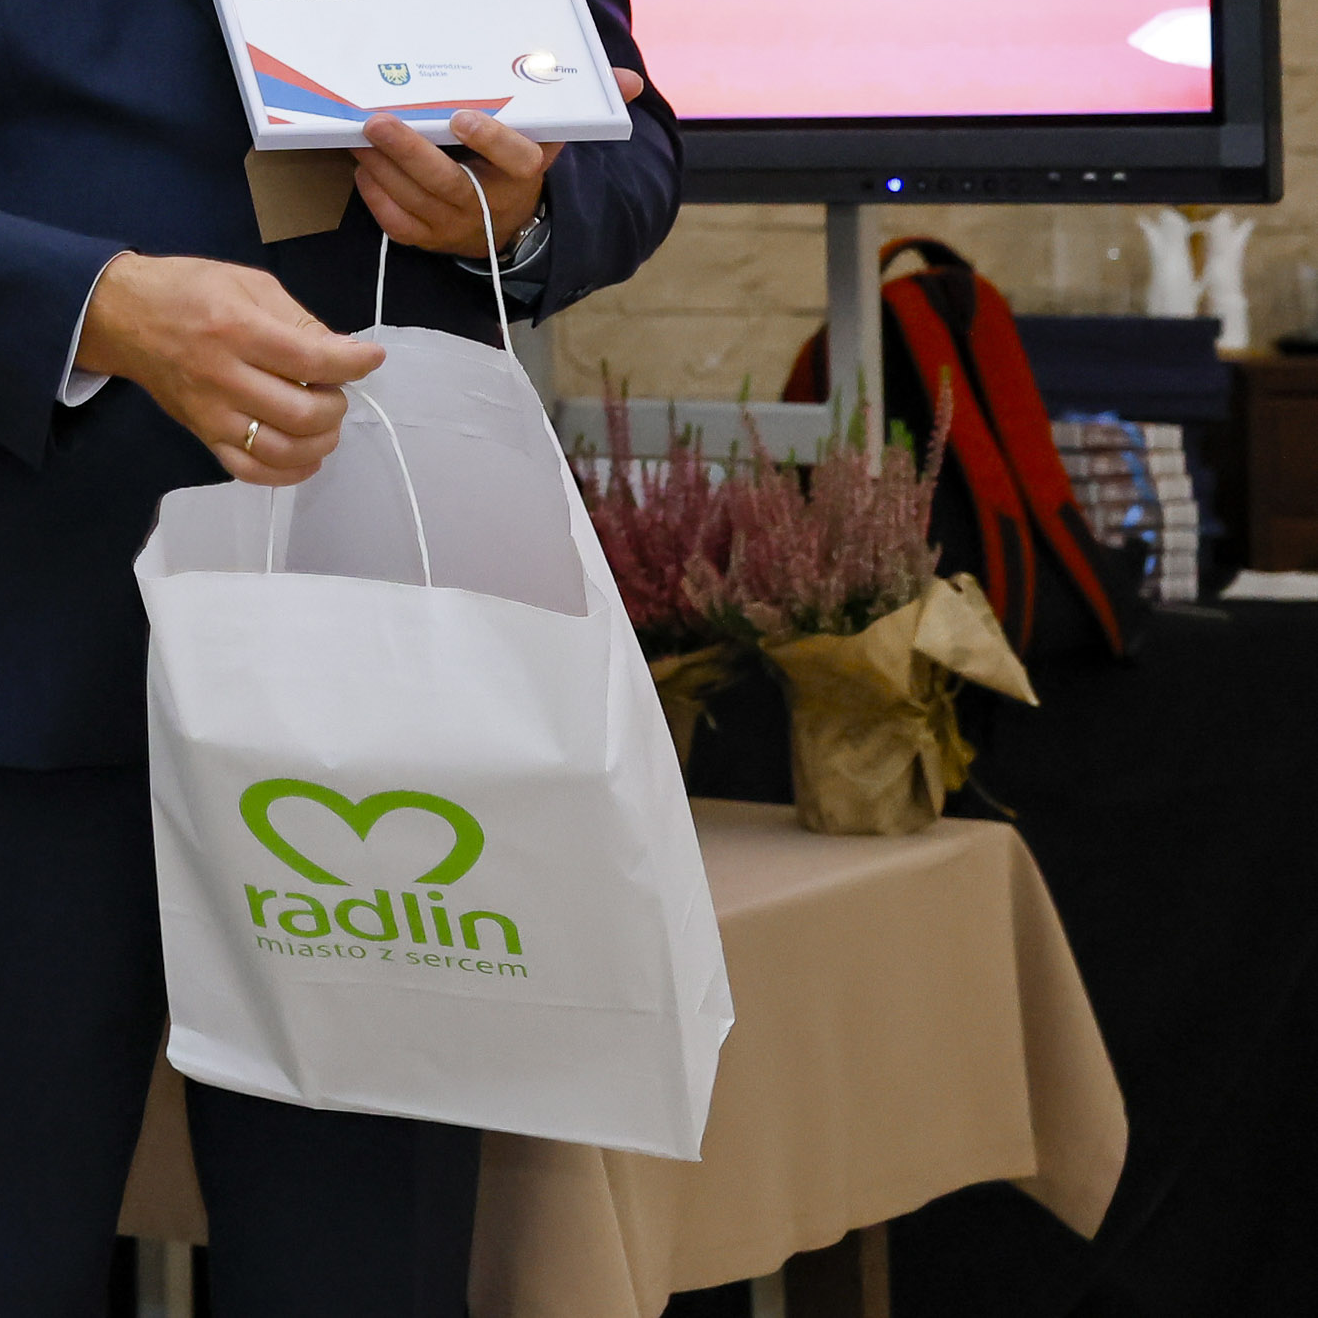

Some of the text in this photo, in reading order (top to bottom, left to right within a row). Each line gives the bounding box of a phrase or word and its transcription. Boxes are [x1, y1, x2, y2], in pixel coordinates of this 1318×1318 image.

[244, 884, 523, 956] radlin
[256, 935, 528, 979] miasto z sercem
